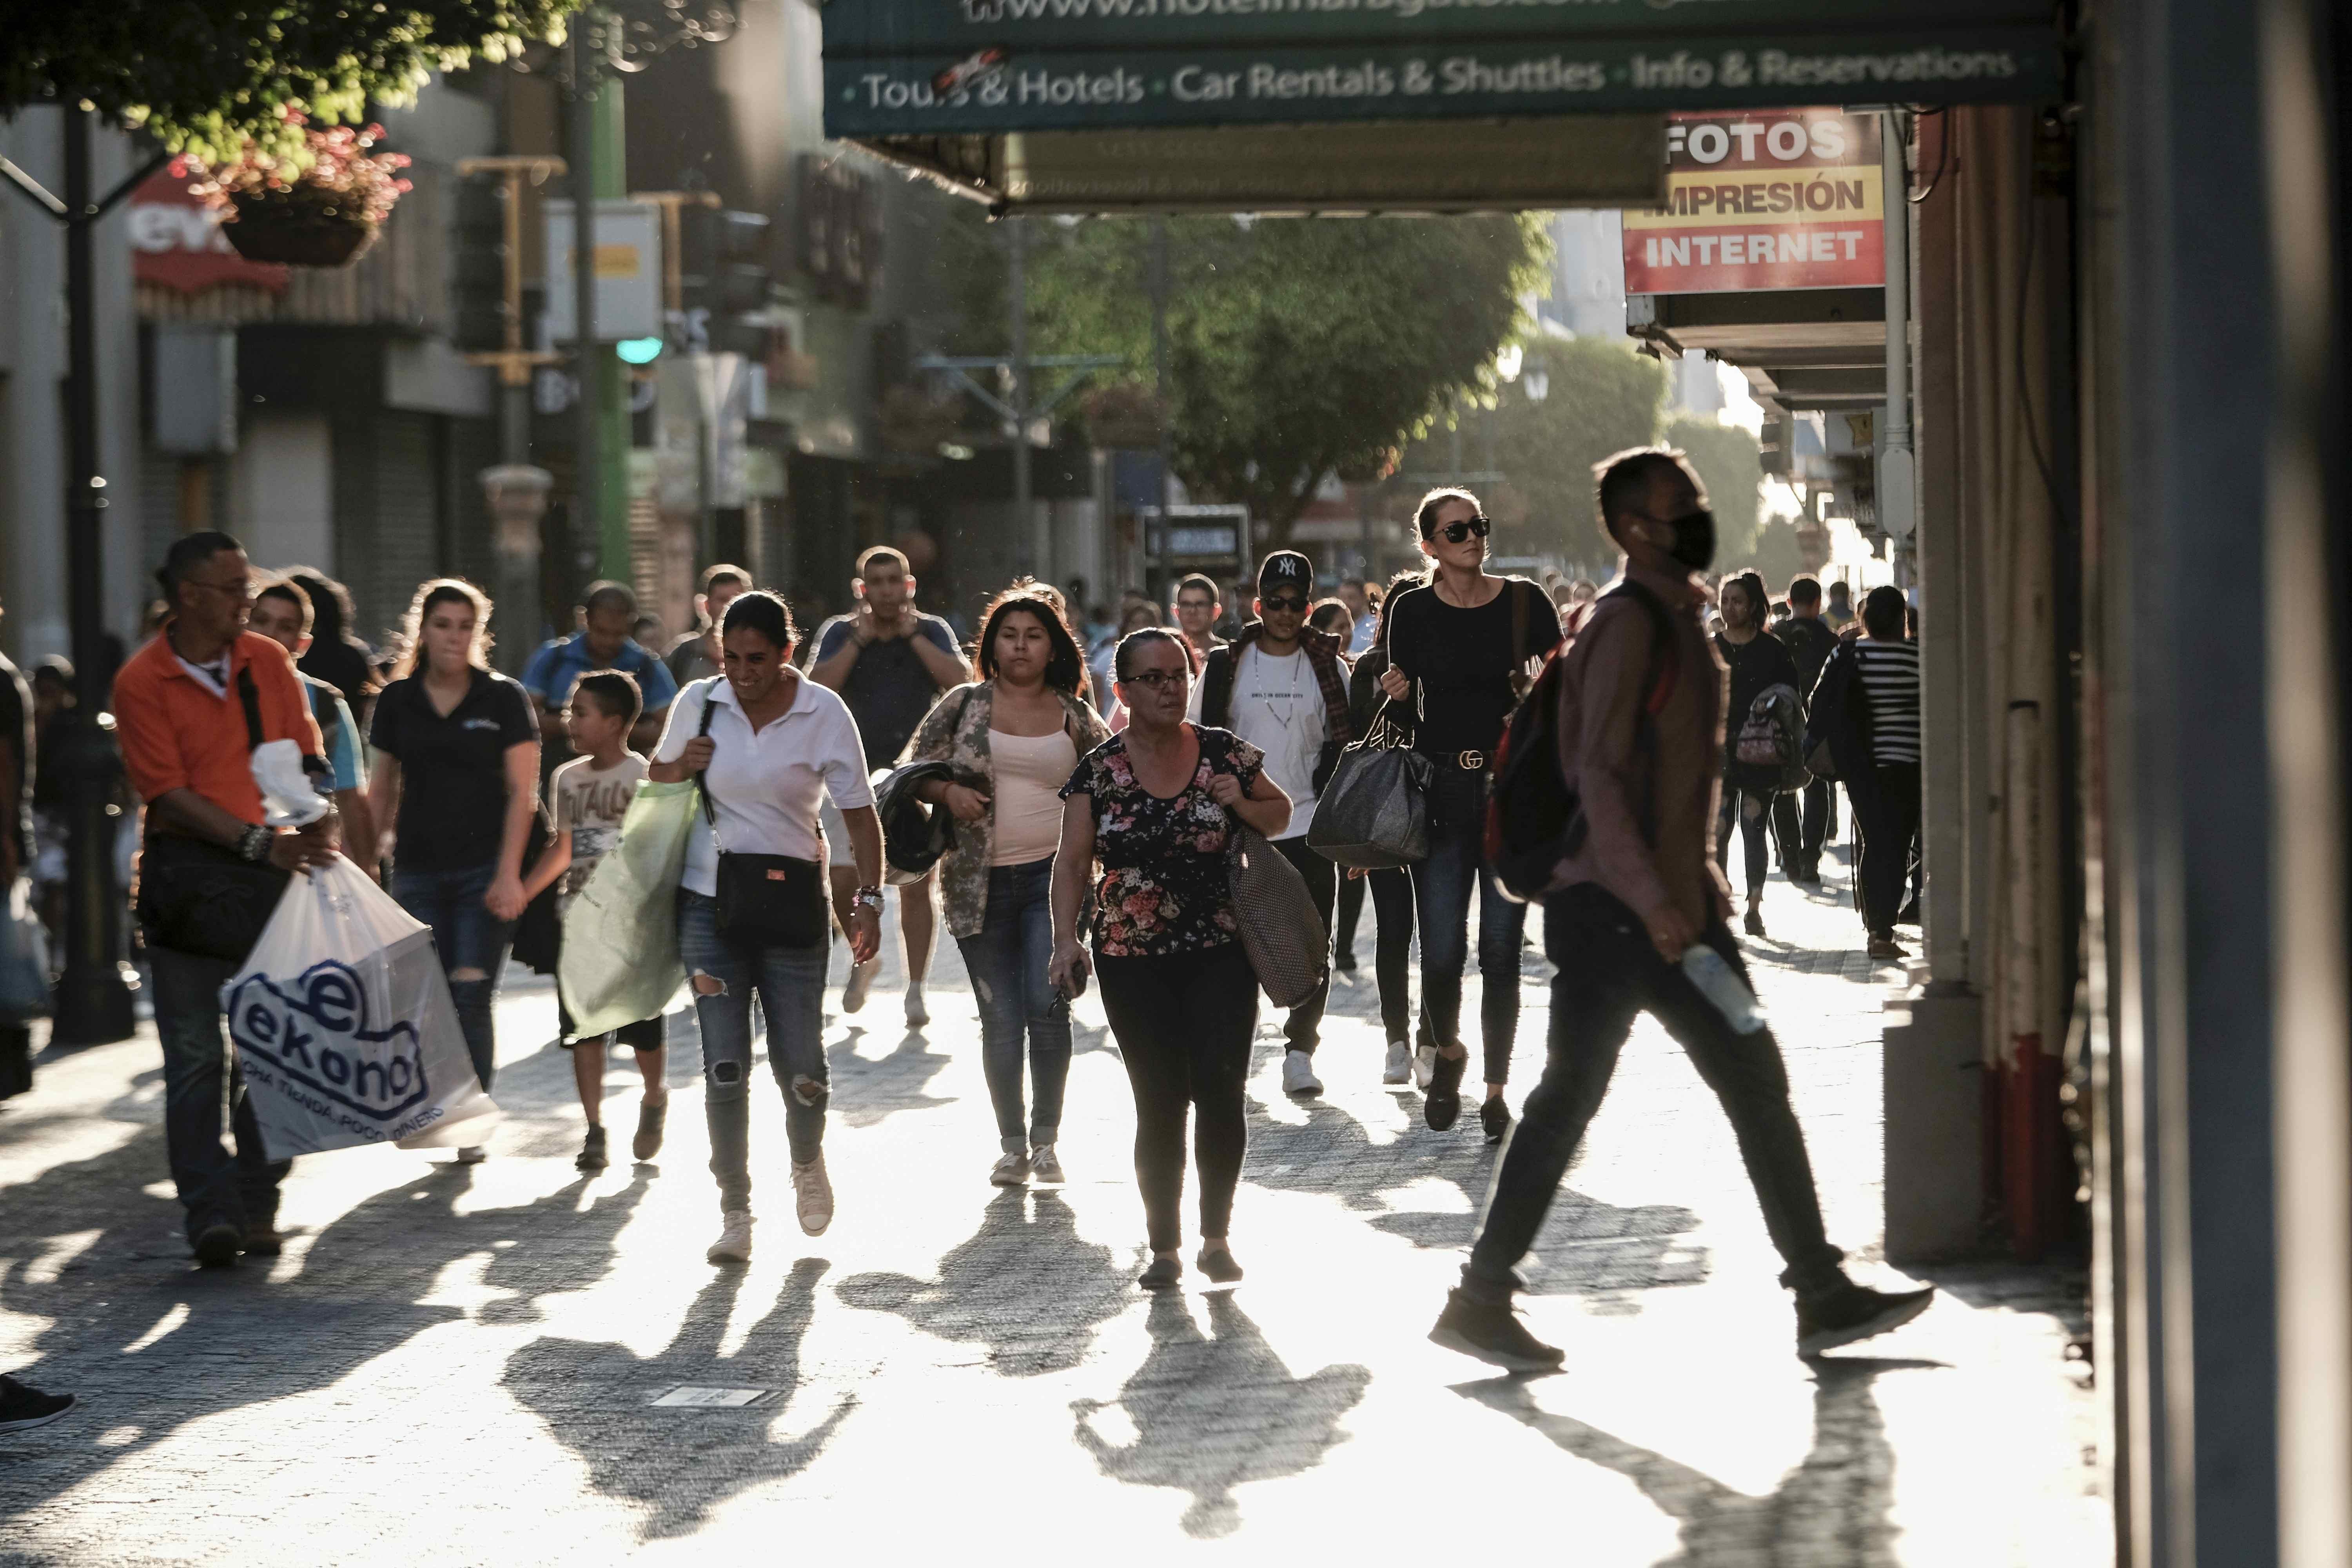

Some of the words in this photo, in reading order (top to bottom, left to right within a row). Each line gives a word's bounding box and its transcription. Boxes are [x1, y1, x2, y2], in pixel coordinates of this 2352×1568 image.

[862, 73, 971, 109] Tous
[980, 67, 1009, 107] &
[1019, 67, 1145, 106] Hotels
[1171, 64, 1241, 101] Car
[1247, 60, 1395, 100] Rentals
[1402, 57, 1434, 95] &
[1439, 53, 1604, 95] Shuttles
[1630, 50, 1714, 89] Info
[1720, 49, 1751, 87] &
[1757, 48, 2017, 85] Reservations
[1664, 121, 1845, 165] FOTOS
[1644, 172, 1864, 217] MPRESIÓN
[1647, 230, 1863, 268] INTERNET
[246, 1003, 412, 1101] ekono
